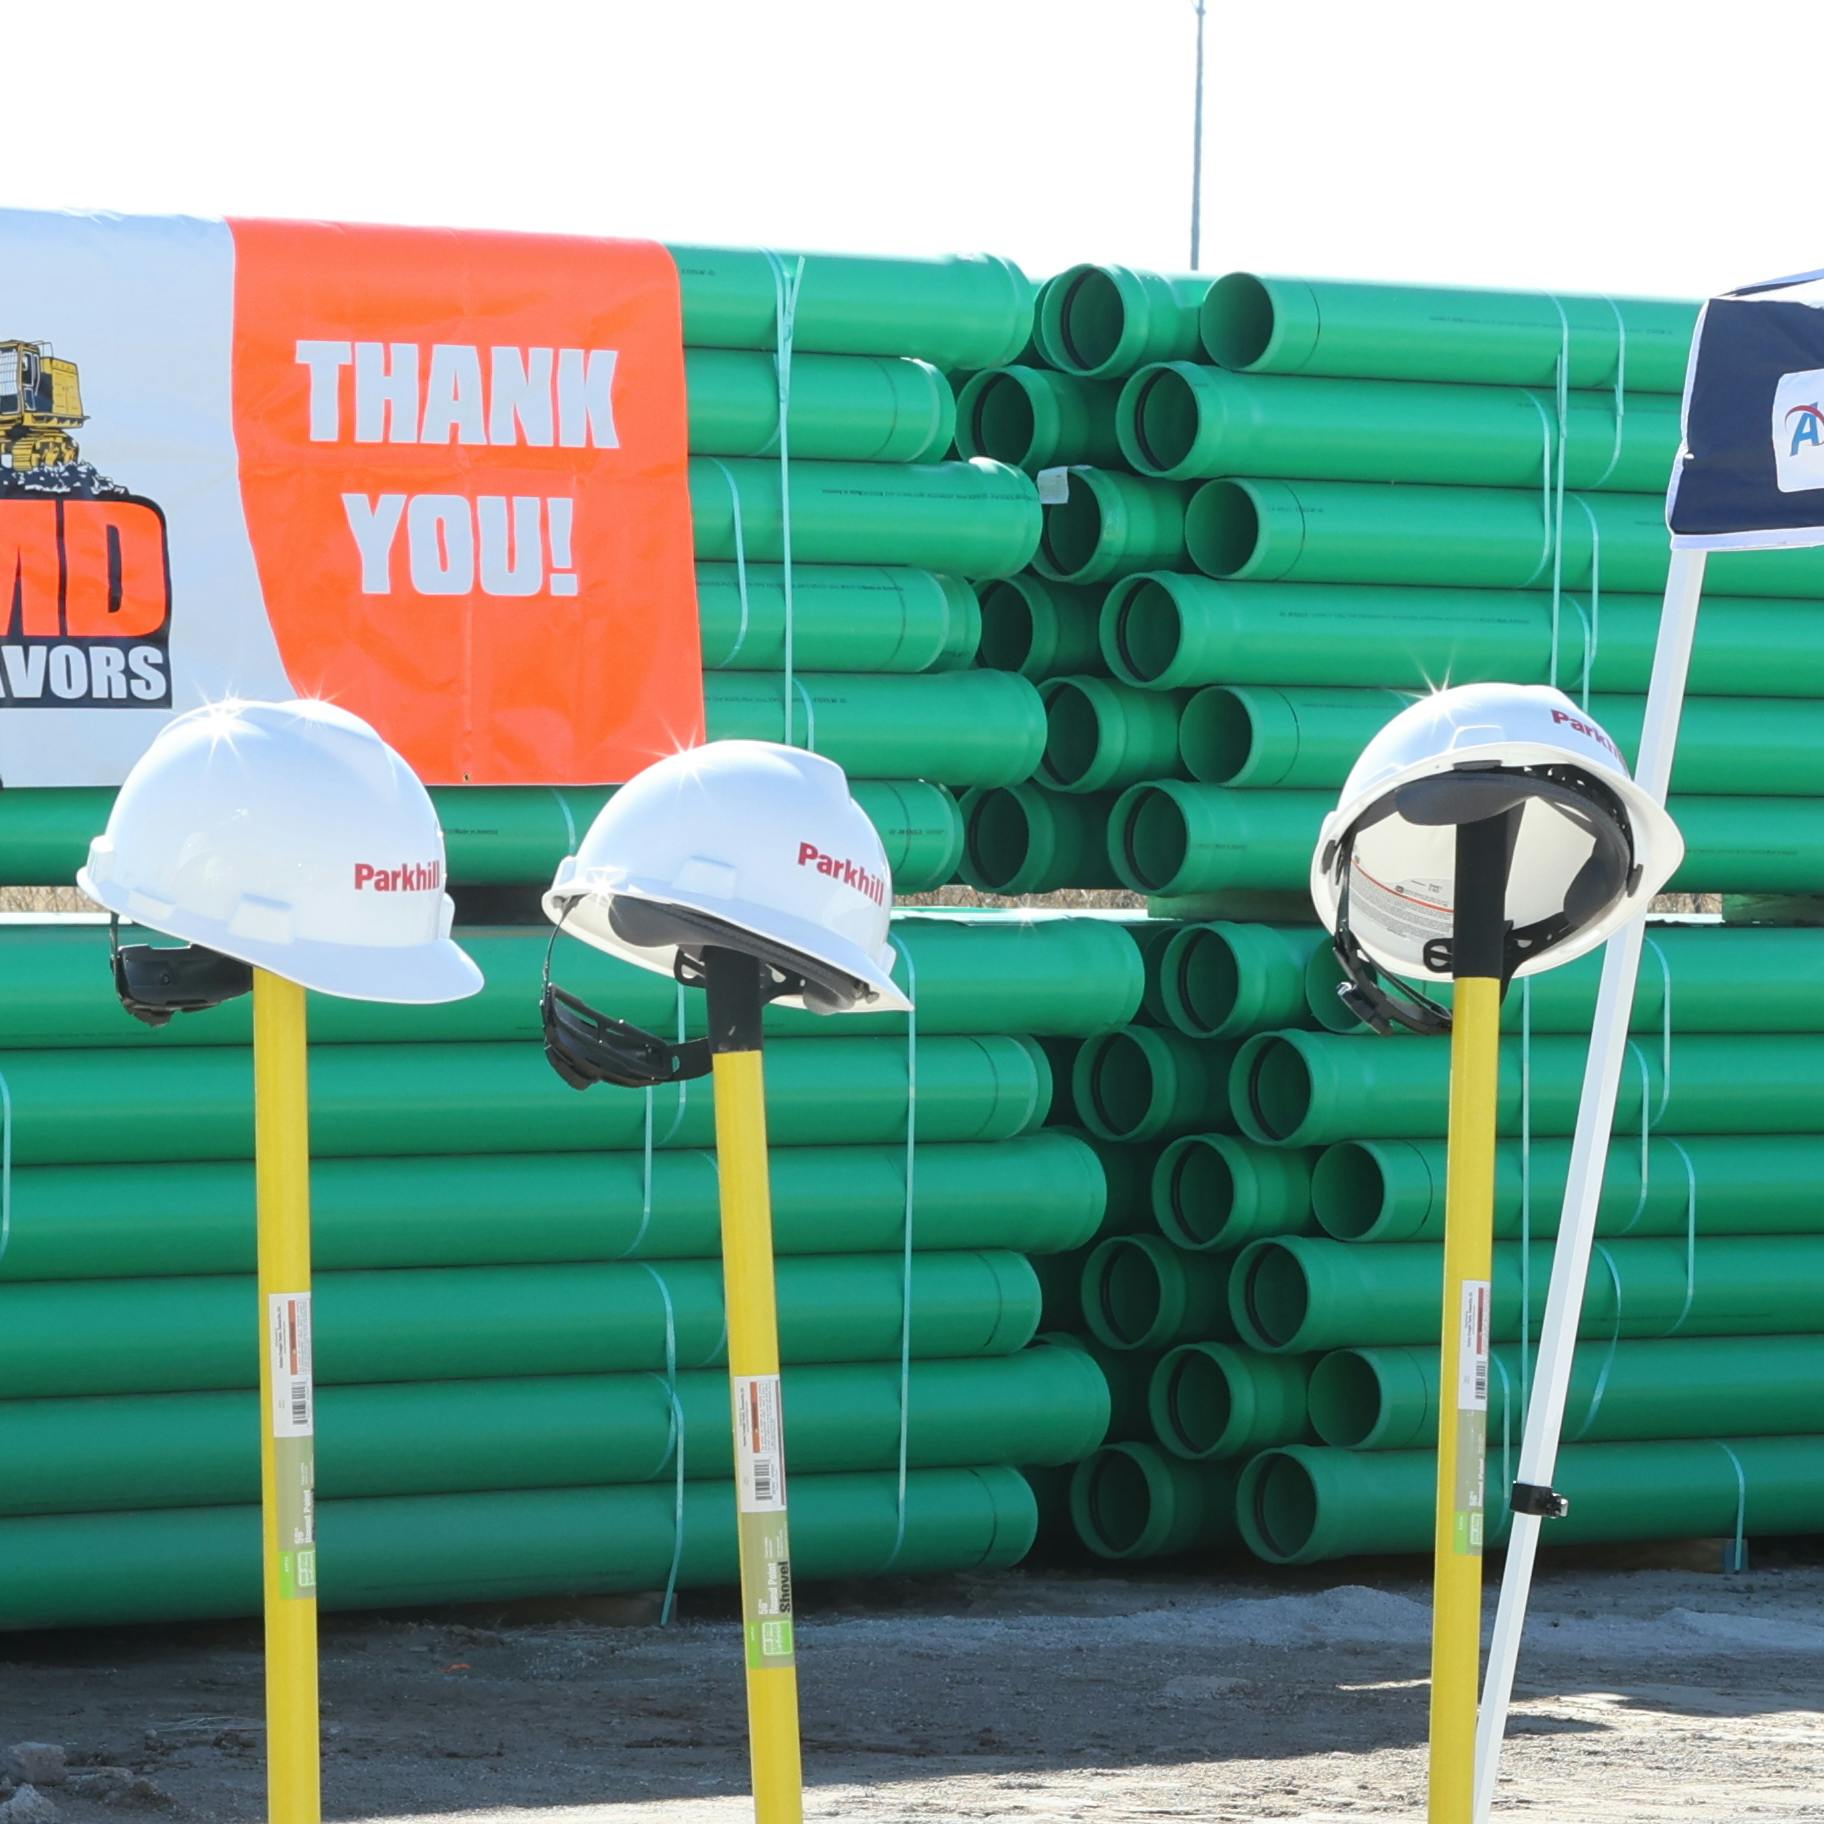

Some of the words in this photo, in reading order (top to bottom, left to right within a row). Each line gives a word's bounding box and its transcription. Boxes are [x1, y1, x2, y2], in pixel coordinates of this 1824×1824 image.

[294, 341, 619, 450] THANK
[343, 493, 578, 598] YOU!
[354, 860, 440, 893] Parkhill
[797, 841, 884, 907] Parkhill
[778, 1561, 791, 1613] Shovel
